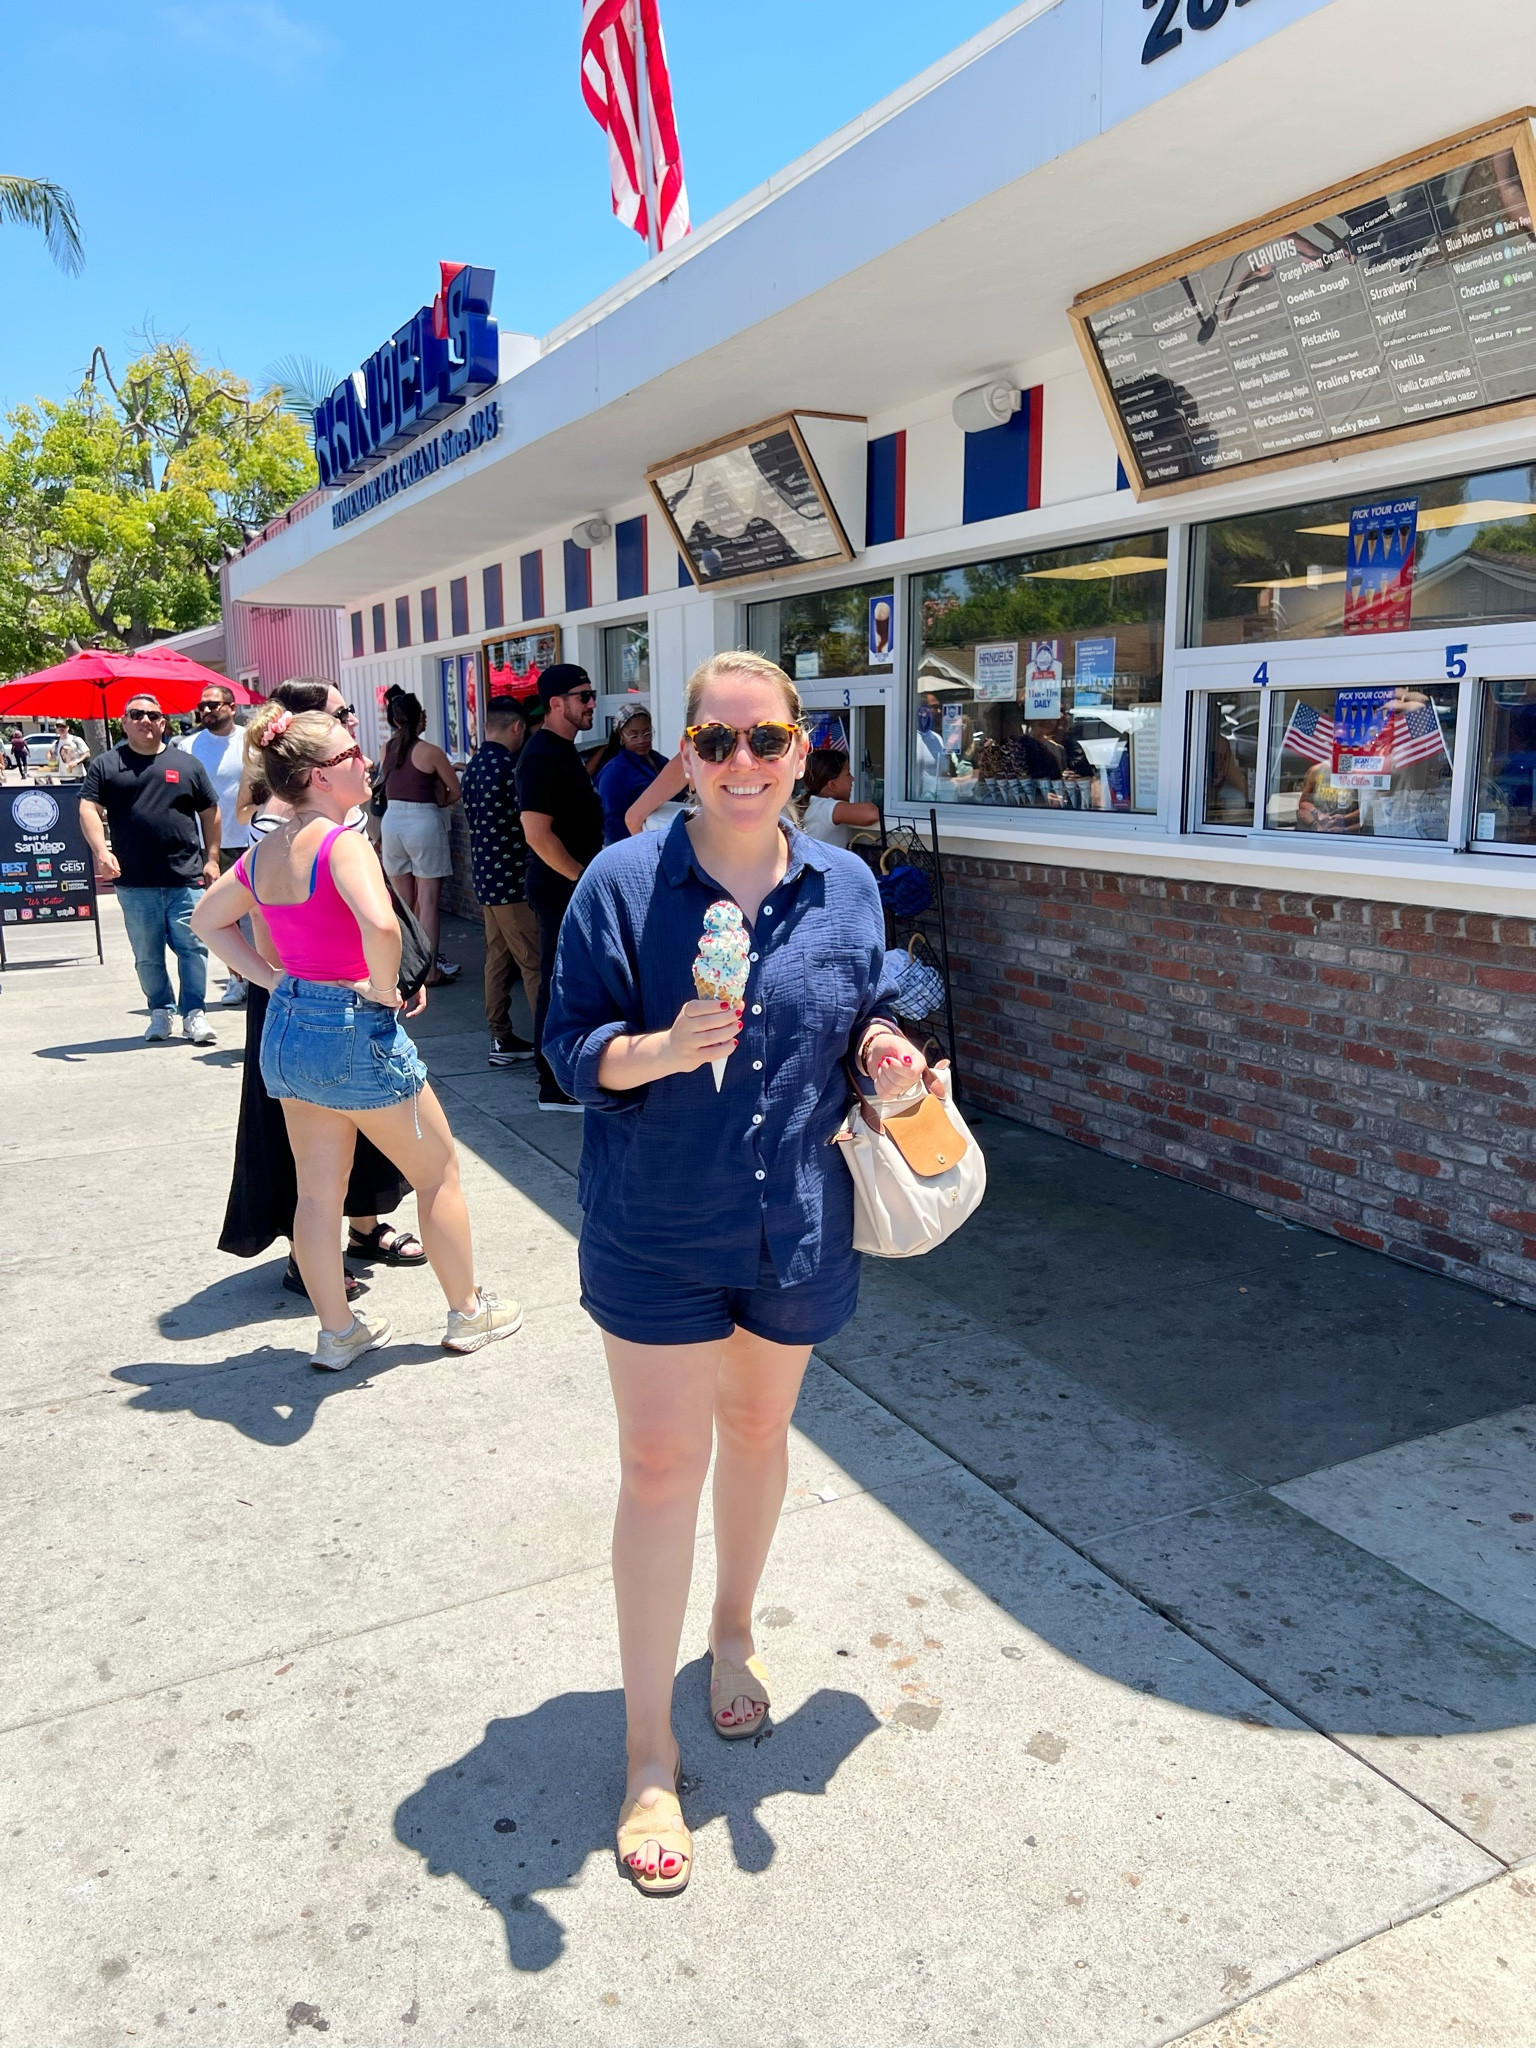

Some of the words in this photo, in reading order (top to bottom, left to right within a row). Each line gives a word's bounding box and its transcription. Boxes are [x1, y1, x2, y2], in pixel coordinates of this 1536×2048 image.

[1350, 224, 1366, 238] Salty
[1363, 211, 1390, 229] Caramel
[1445, 238, 1463, 252] Blue
[1462, 231, 1483, 246] Moon
[1480, 227, 1494, 240] Ice
[1247, 239, 1298, 272] FLAVORS
[1279, 259, 1303, 282] Orange
[1302, 256, 1324, 275] Dream
[1322, 247, 1346, 266] Cream
[1453, 255, 1493, 274] Watermelon
[1492, 251, 1504, 262] Ice
[1370, 278, 1418, 301] Strawberry
[1460, 278, 1500, 298] Chocolate
[1512, 272, 1534, 283] Vegan
[1292, 309, 1321, 327] Peach
[1376, 308, 1408, 328] Twixter
[1468, 311, 1492, 322] Mango
[1300, 328, 1340, 348] Pistachio
[1383, 336, 1406, 348] Graham
[1406, 330, 1430, 342] Central
[1429, 324, 1452, 337] Station
[1233, 354, 1262, 370] Midnight
[1259, 348, 1288, 362] Madness
[1390, 352, 1426, 371] Vanilla
[1239, 373, 1264, 392] Monkey
[1262, 368, 1291, 385] Business
[1316, 372, 1350, 392] Praline
[1349, 364, 1380, 381] Pecan
[1396, 380, 1419, 394] Vanilla
[1418, 373, 1445, 389] Caramel
[1444, 364, 1472, 381] Brownie
[1252, 416, 1270, 430] Mint
[1268, 408, 1300, 428] Chocolate
[1298, 405, 1314, 420] Chip
[1330, 420, 1358, 436] Rocky
[1356, 414, 1380, 430] Road
[398, 437, 441, 490] CREAM
[440, 428, 471, 467] Since
[1201, 454, 1223, 466] Cotton
[1222, 448, 1242, 460] Candy
[1352, 510, 1368, 520] PICK
[1371, 504, 1392, 516] YOUR
[1393, 500, 1416, 513] CONE
[1445, 644, 1469, 678] 5
[1252, 661, 1269, 686] 4
[843, 689, 850, 707] 3
[1034, 700, 1052, 708] DAILY
[1338, 692, 1354, 700] PICK
[1354, 692, 1372, 700] YOUR
[1374, 691, 1392, 699] CONE
[22, 834, 40, 842] Best
[1, 862, 28, 874] BEST
[60, 862, 86, 872] GEIST
